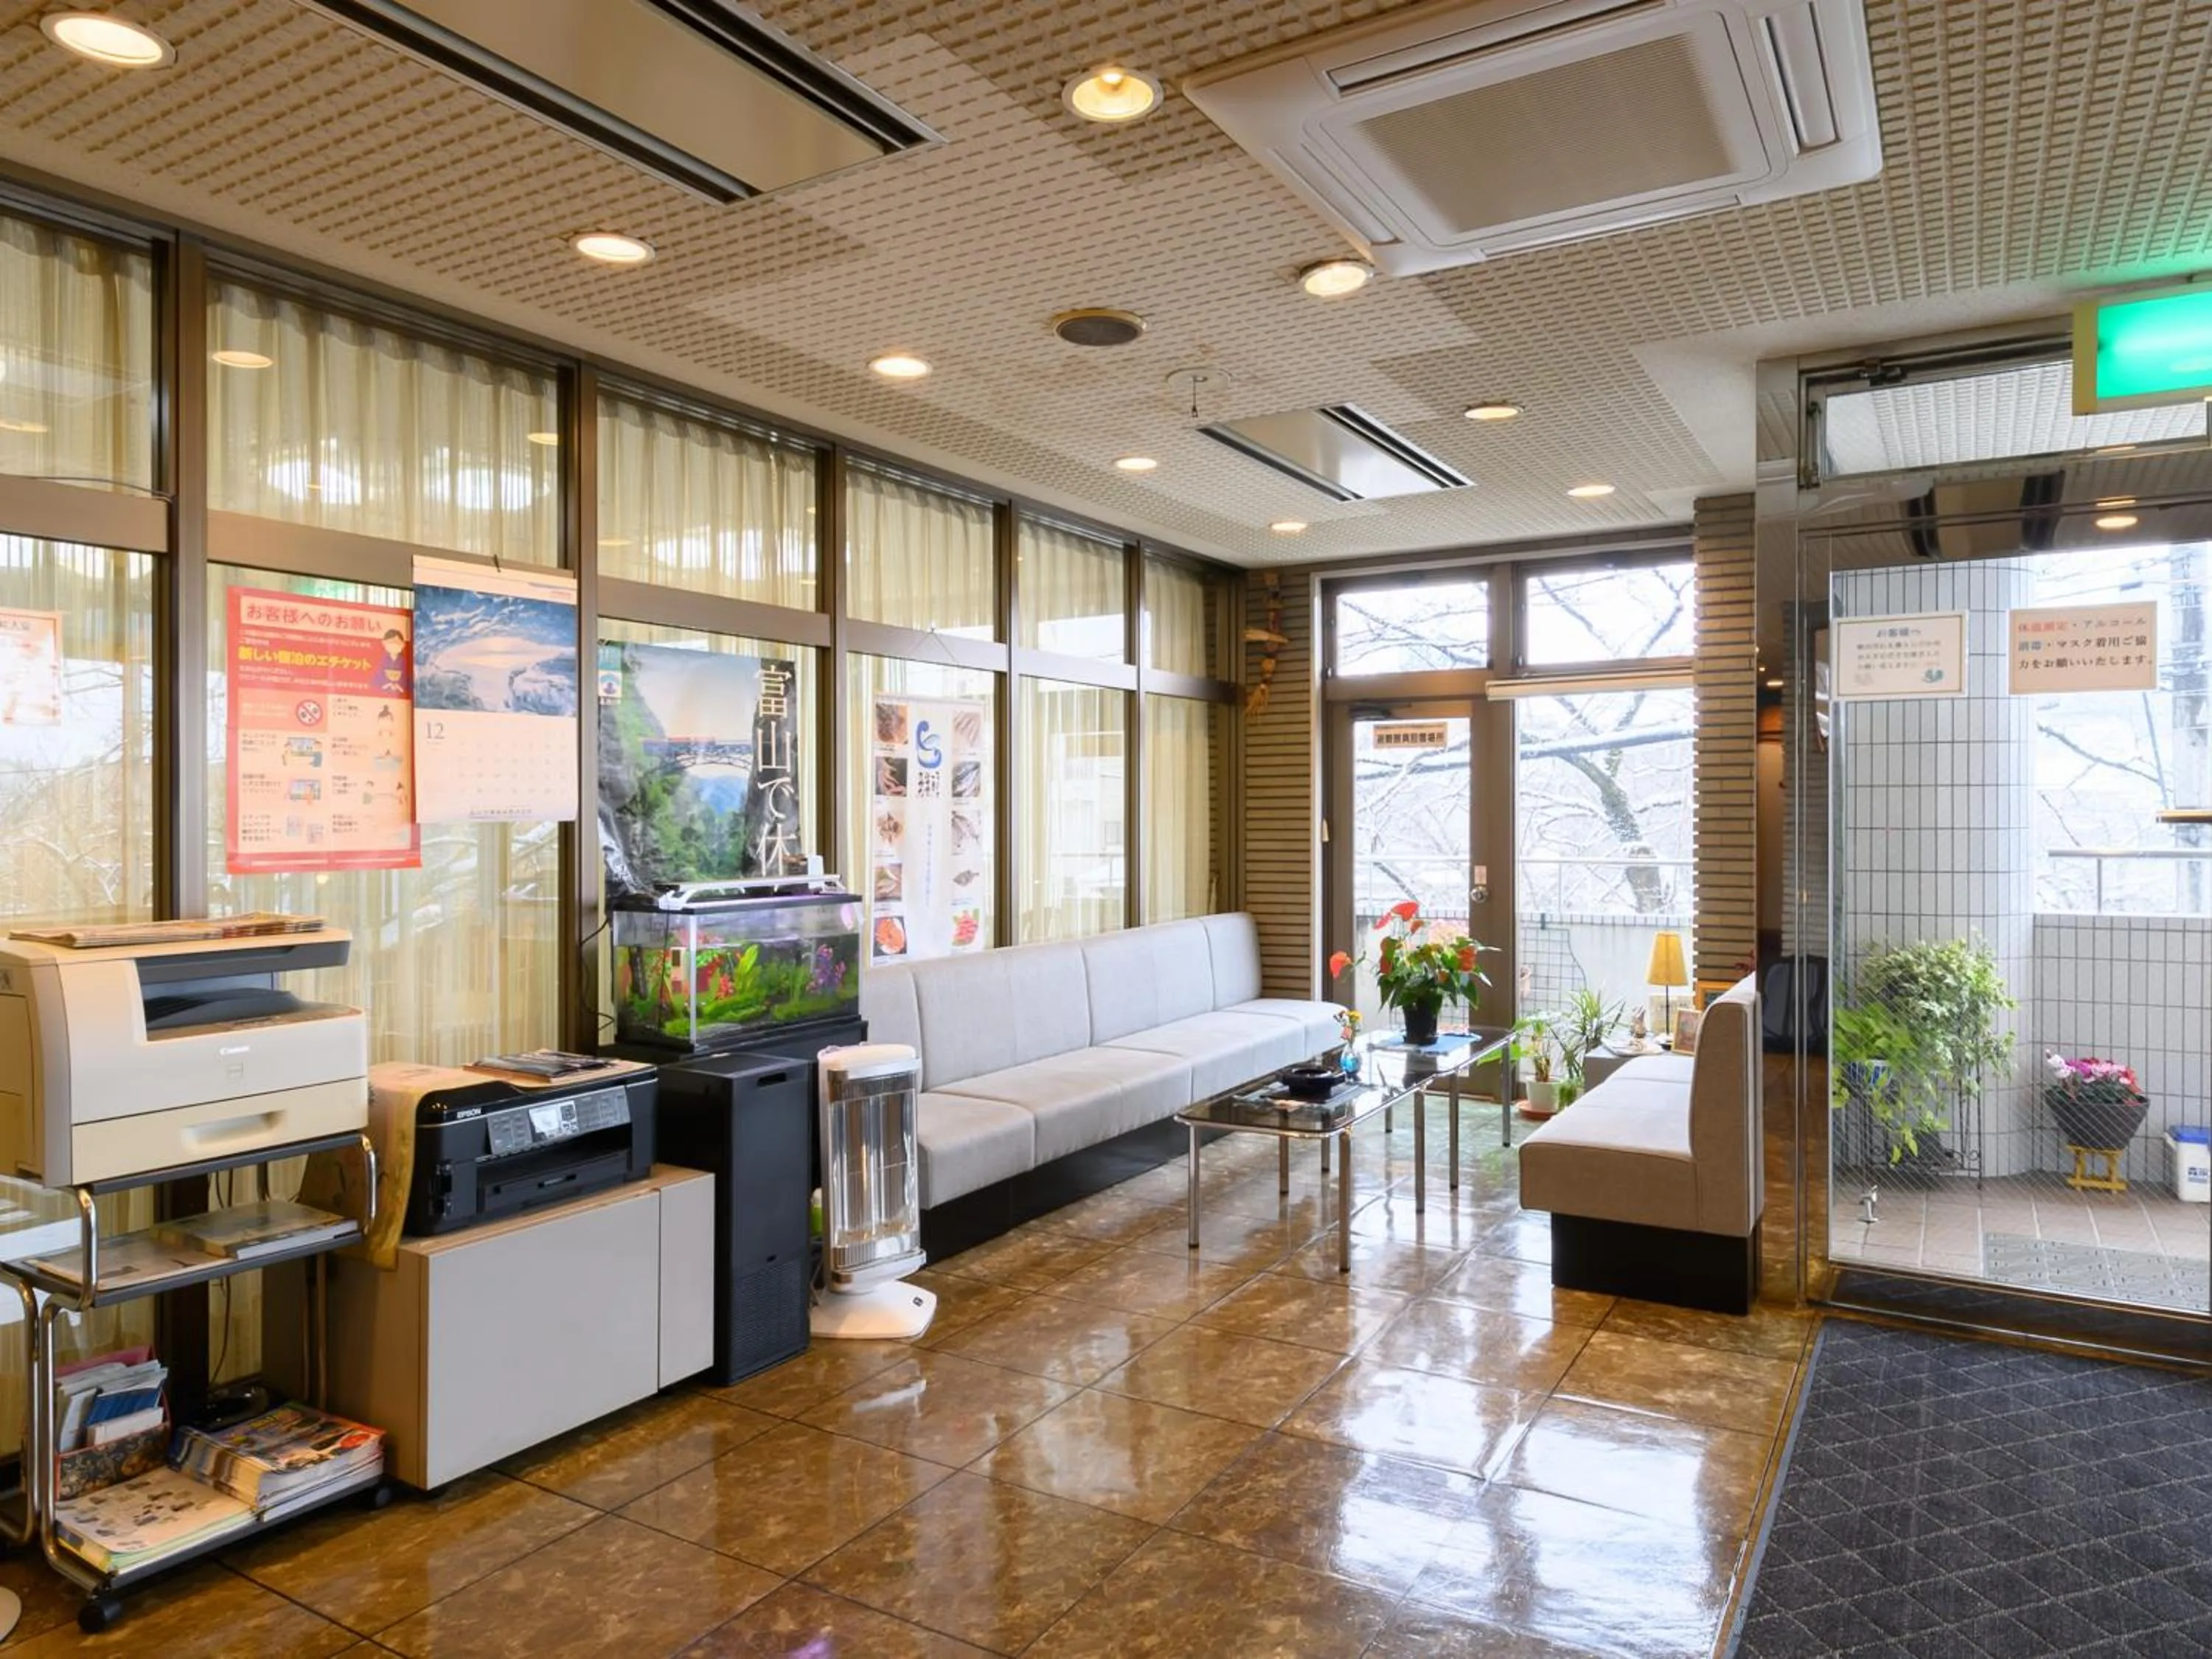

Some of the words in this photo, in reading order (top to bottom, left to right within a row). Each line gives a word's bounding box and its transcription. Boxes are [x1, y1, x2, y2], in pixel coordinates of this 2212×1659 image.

[247, 603, 381, 632] お客様へのお願い
[2018, 636, 2147, 651] 消毒・マスク着用ご協
[2019, 655, 2152, 669] 力をお願いいたします。
[425, 721, 445, 740] 12
[456, 1108, 482, 1119] EPSON
